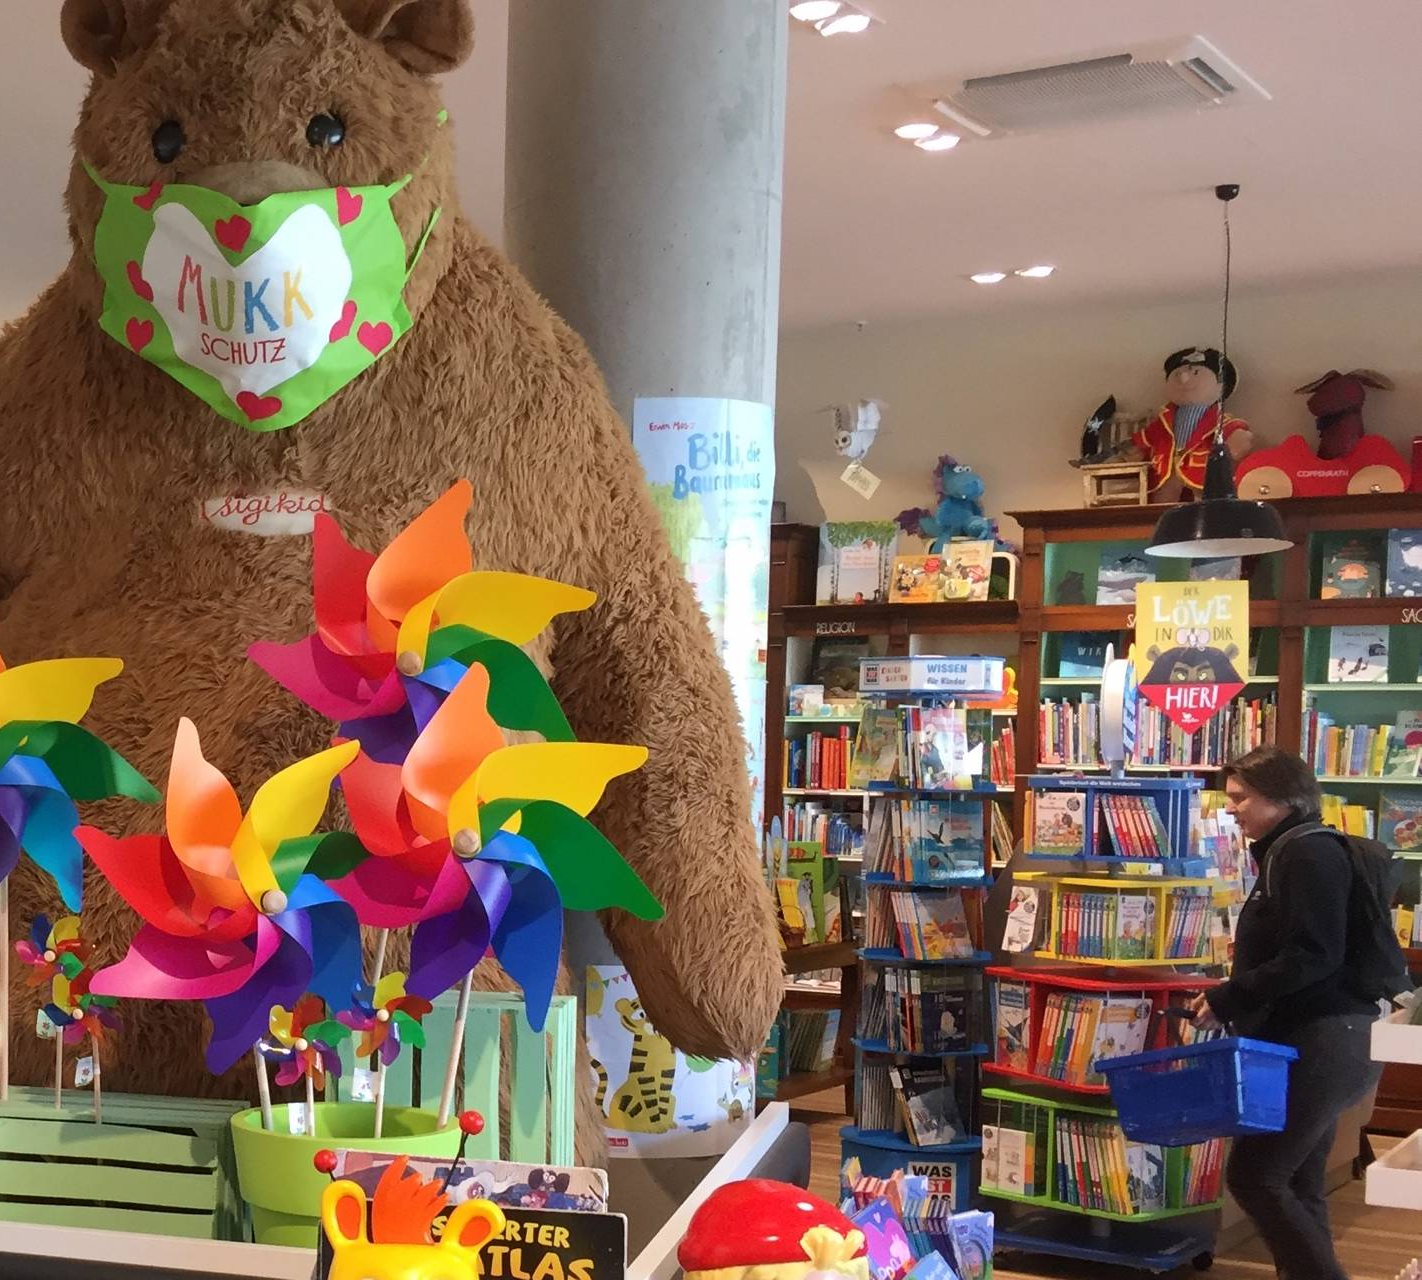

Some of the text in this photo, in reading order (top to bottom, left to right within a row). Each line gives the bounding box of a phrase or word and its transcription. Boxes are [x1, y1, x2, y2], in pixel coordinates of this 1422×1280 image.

[178, 255, 314, 334] MUKK
[201, 333, 286, 365] SCHUTZ
[215, 490, 331, 525] sigikid
[1152, 594, 1233, 627] LÖWE
[816, 621, 856, 635] RELIGION
[1155, 628, 1173, 641] IN
[927, 663, 968, 673] WISSEN
[1165, 685, 1219, 711] HIER!
[912, 1164, 952, 1178] WAS
[928, 1180, 946, 1194] ST
